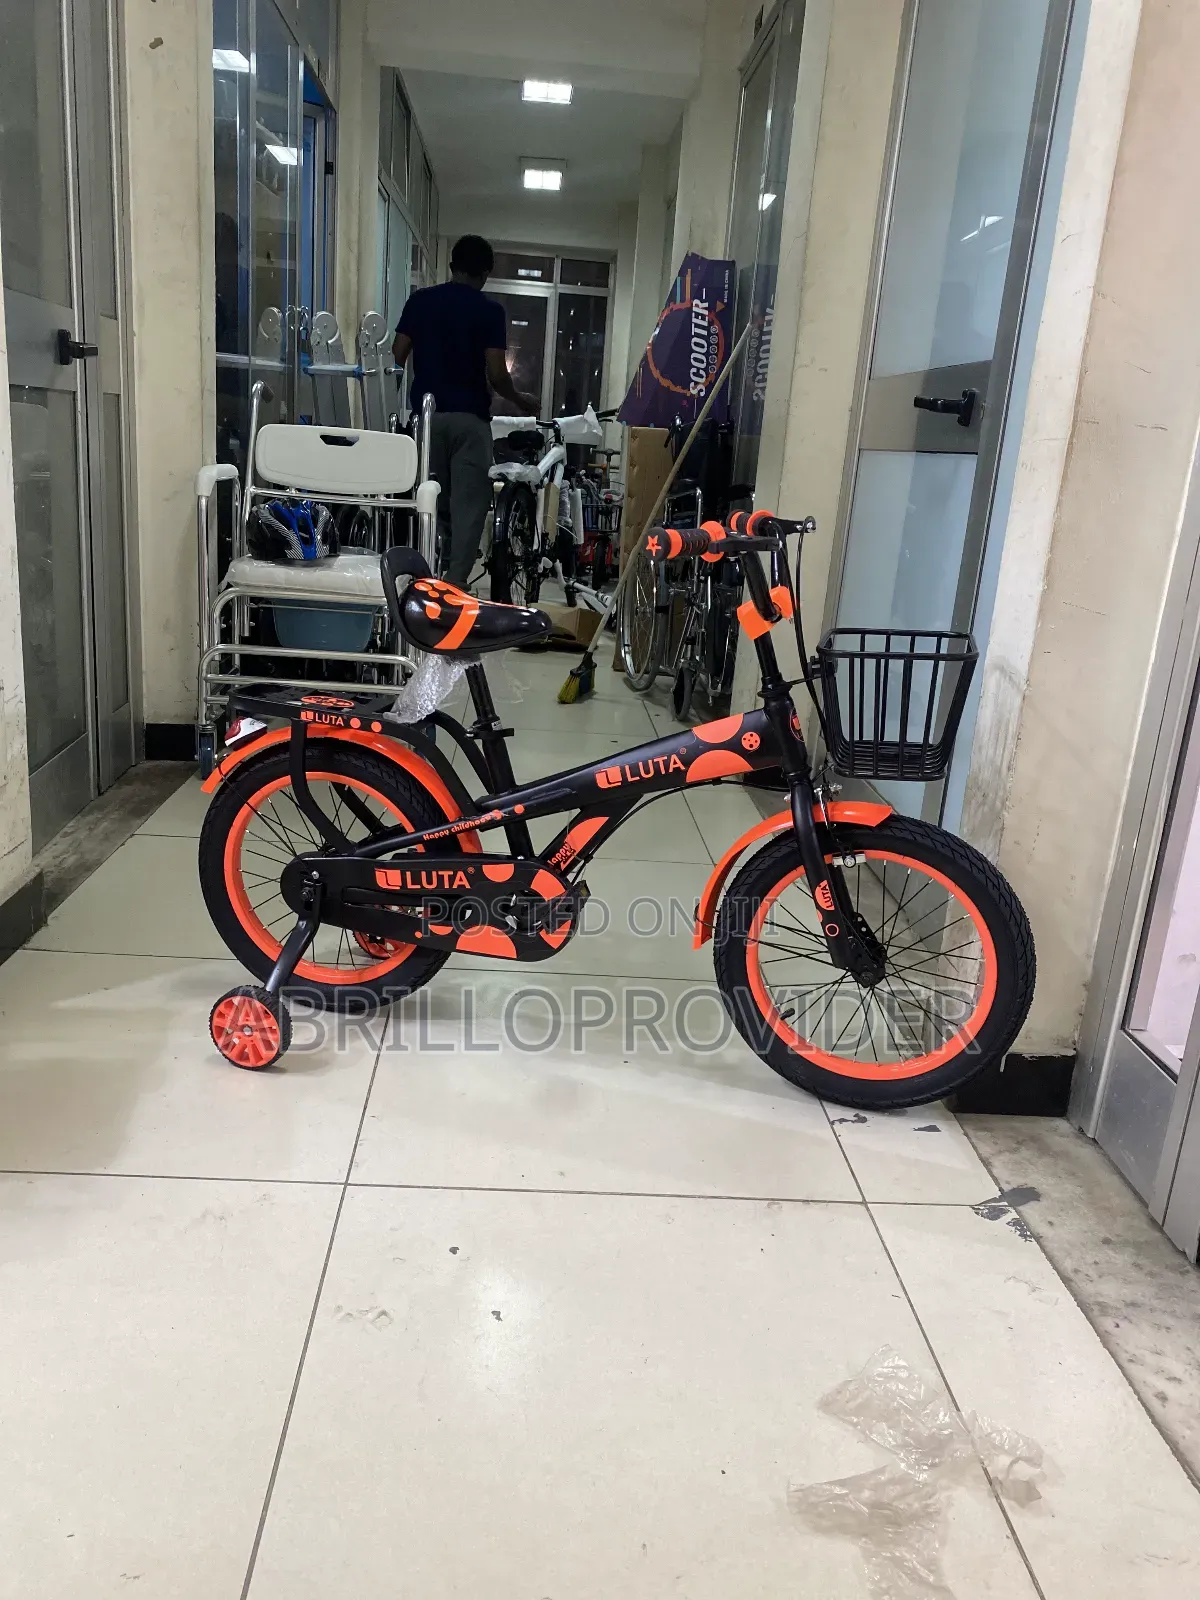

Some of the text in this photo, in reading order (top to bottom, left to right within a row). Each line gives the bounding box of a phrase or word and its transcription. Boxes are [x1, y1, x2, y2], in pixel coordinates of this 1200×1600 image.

[690, 299, 709, 397] SCOOTER
[315, 712, 344, 726] LUTA
[423, 829, 450, 841] Happy
[821, 884, 833, 908] LUTA
